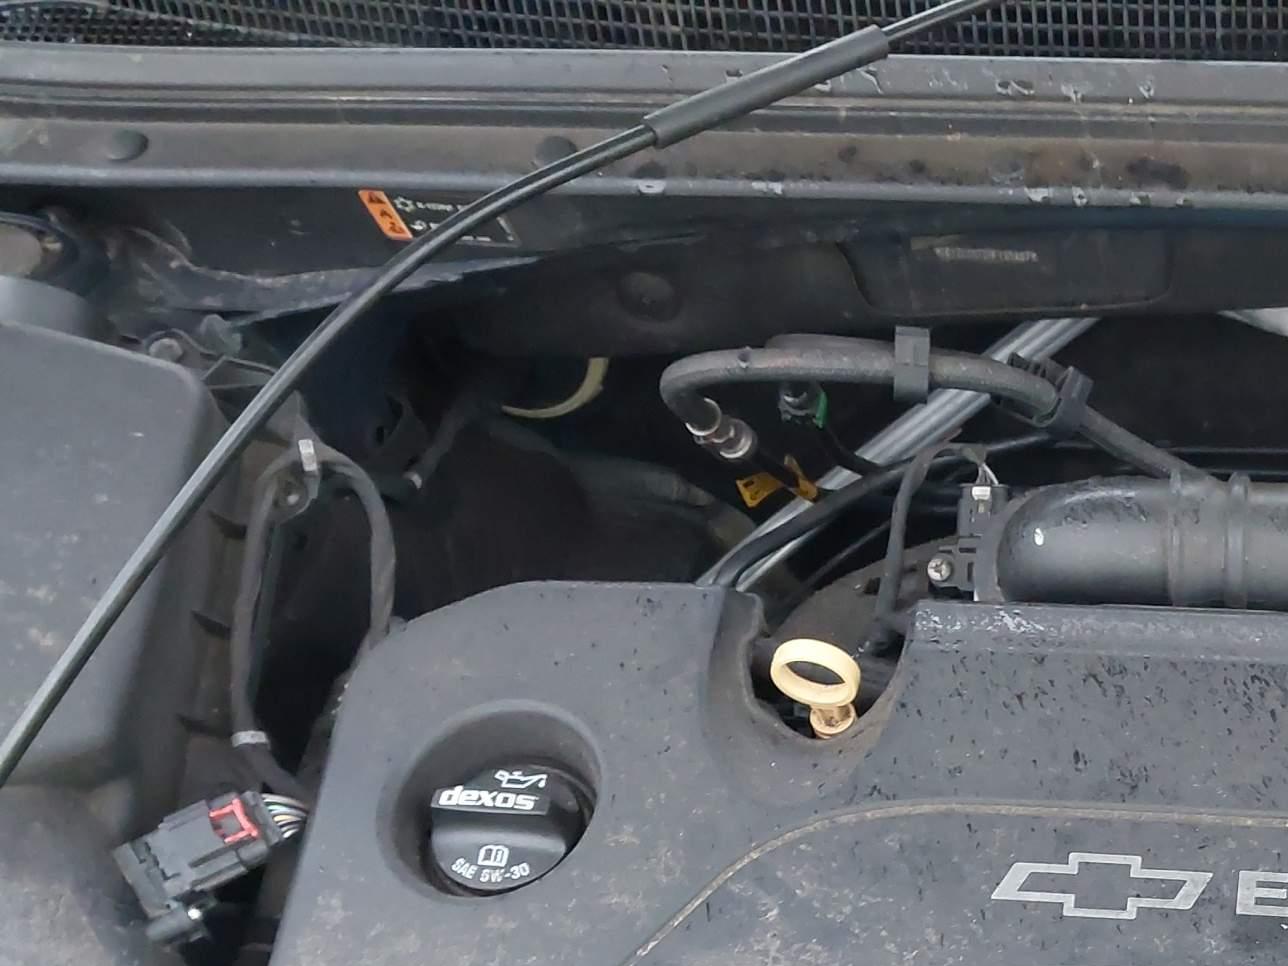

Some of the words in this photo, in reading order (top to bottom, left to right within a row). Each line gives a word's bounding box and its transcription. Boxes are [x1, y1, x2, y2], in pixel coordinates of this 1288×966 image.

[438, 785, 539, 811] dexos
[451, 857, 479, 879] SAE
[480, 863, 530, 883] 5W-30
